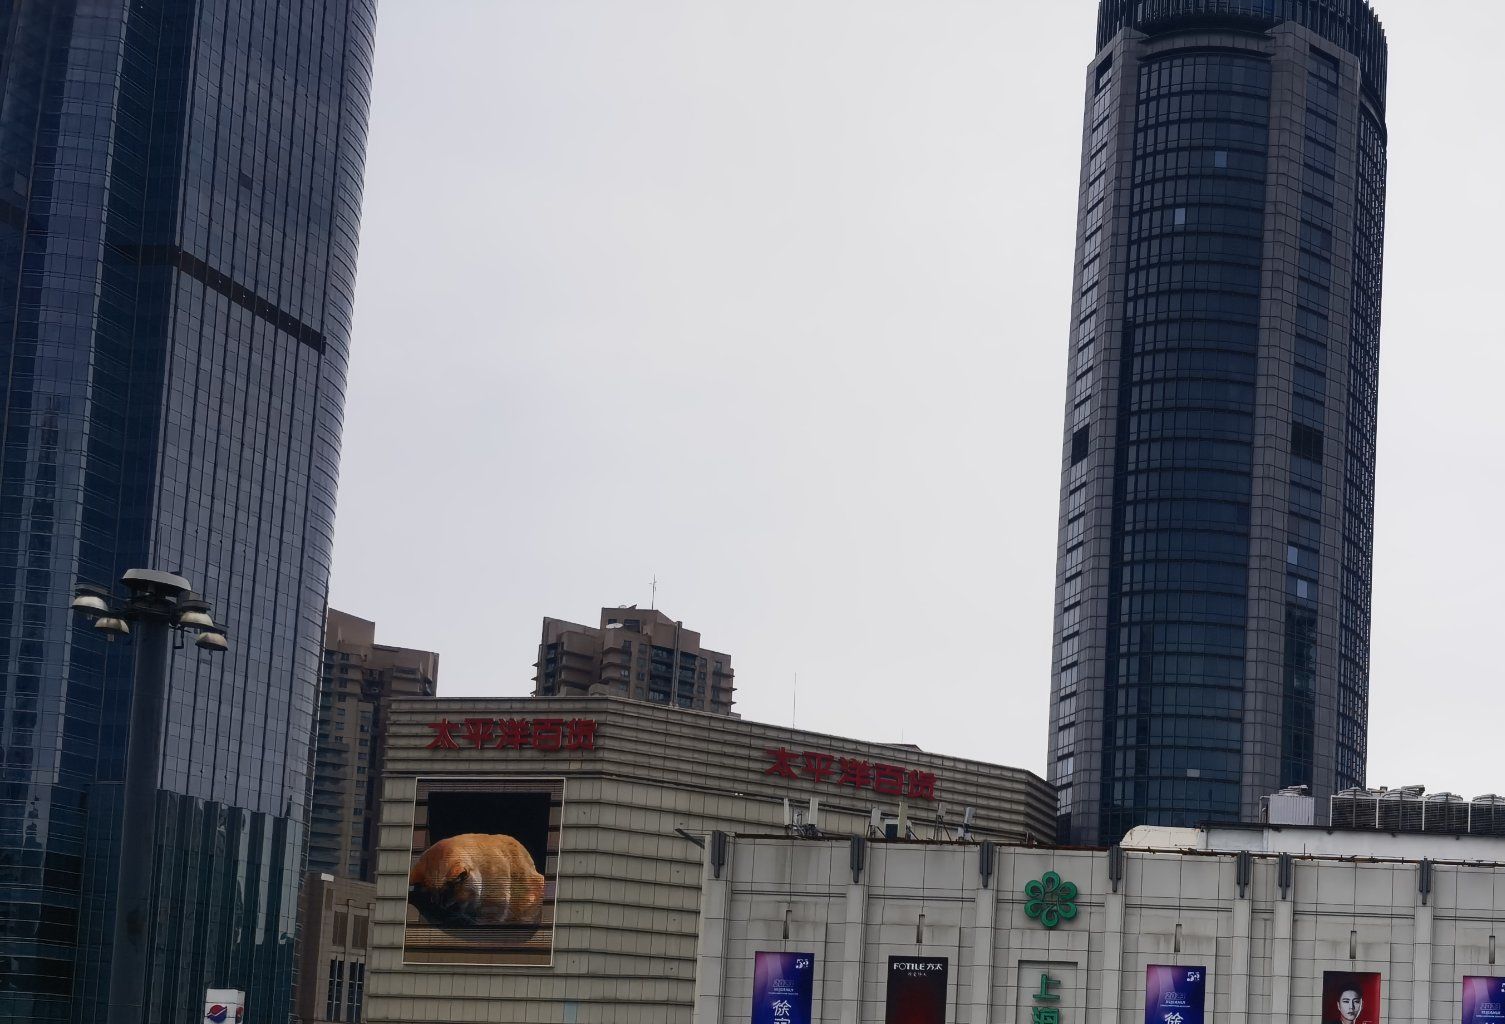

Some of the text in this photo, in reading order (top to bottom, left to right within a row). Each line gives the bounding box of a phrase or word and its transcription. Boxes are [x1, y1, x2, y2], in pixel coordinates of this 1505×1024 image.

[425, 717, 598, 752] 太平洋百货
[764, 746, 939, 801] 太平洋百货
[893, 962, 943, 971] FOTILE 方太
